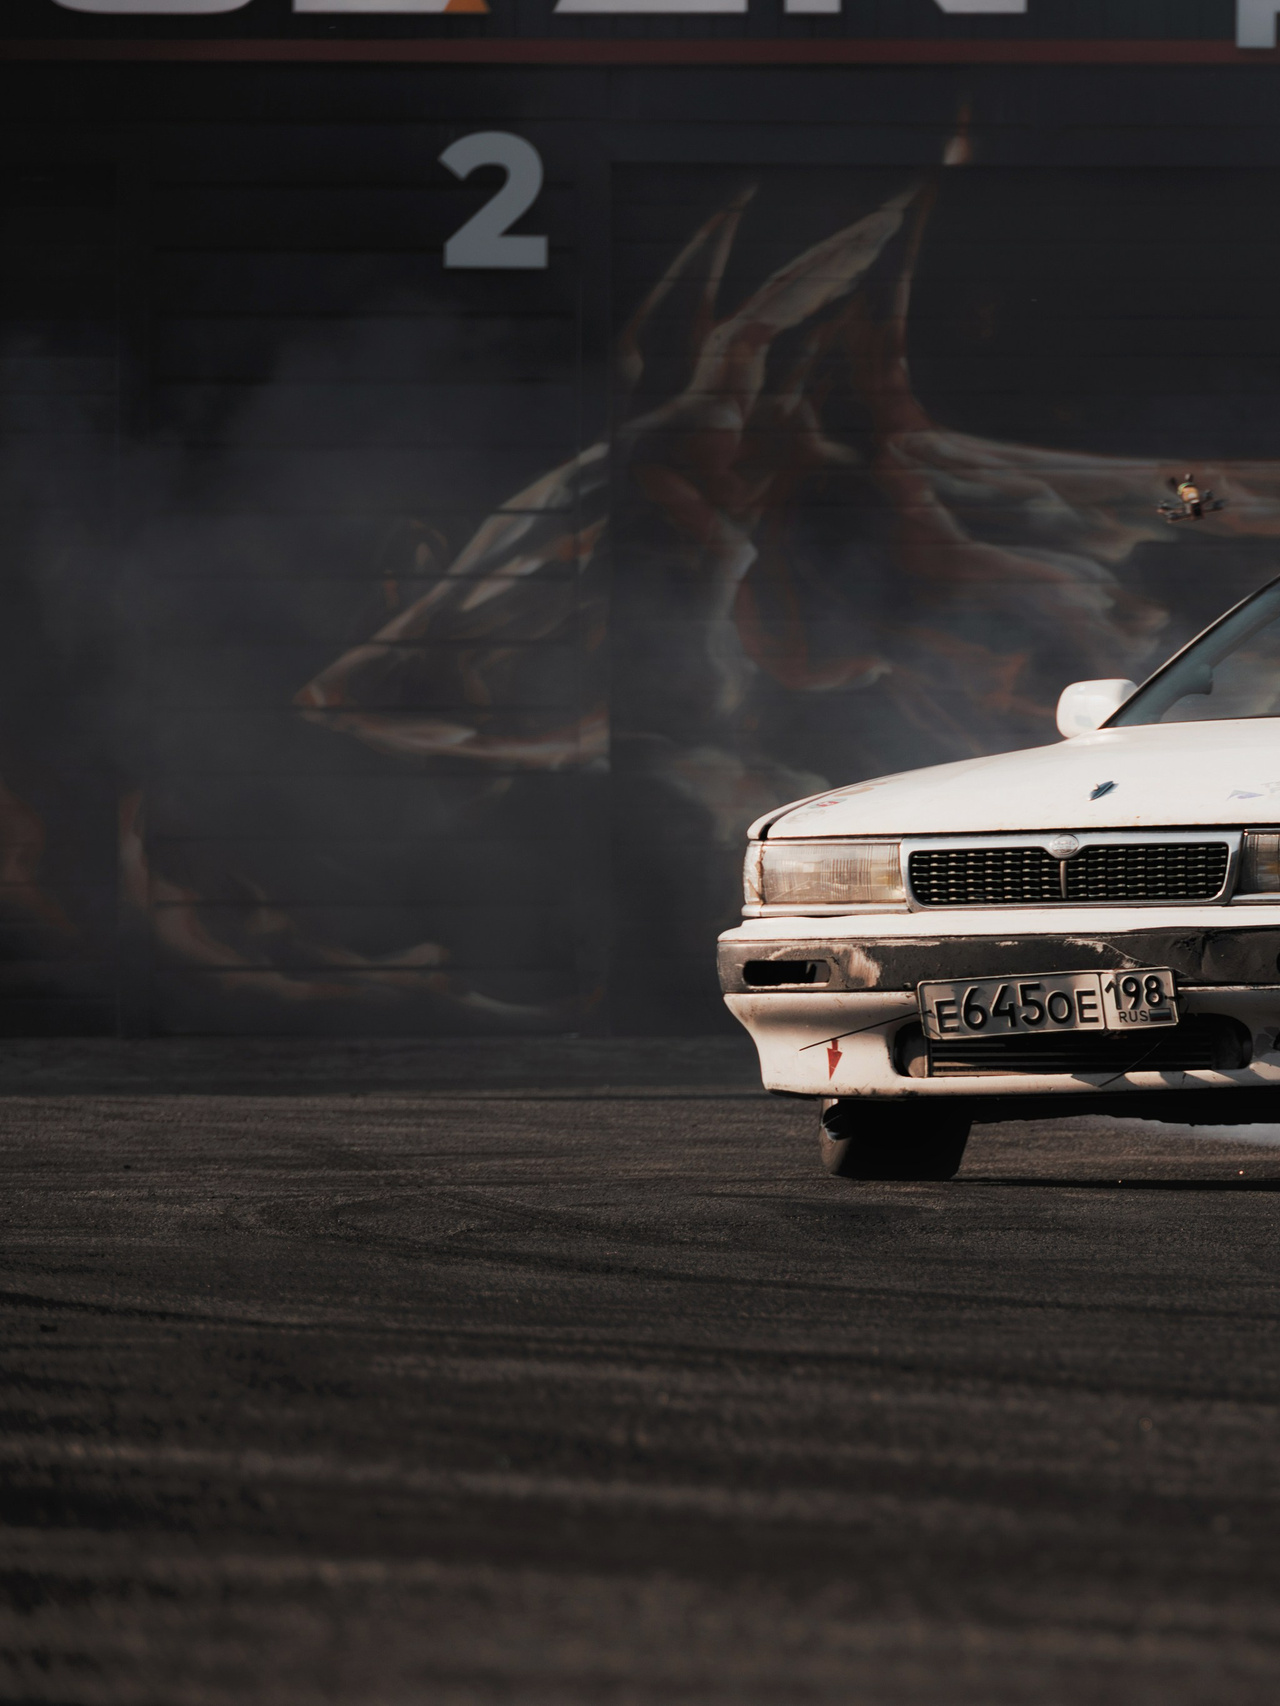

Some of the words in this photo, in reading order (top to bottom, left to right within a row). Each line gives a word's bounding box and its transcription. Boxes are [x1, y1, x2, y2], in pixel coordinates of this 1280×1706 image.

[438, 130, 548, 269] 2
[1105, 974, 1162, 1011] 198
[1119, 1009, 1149, 1023] RUS
